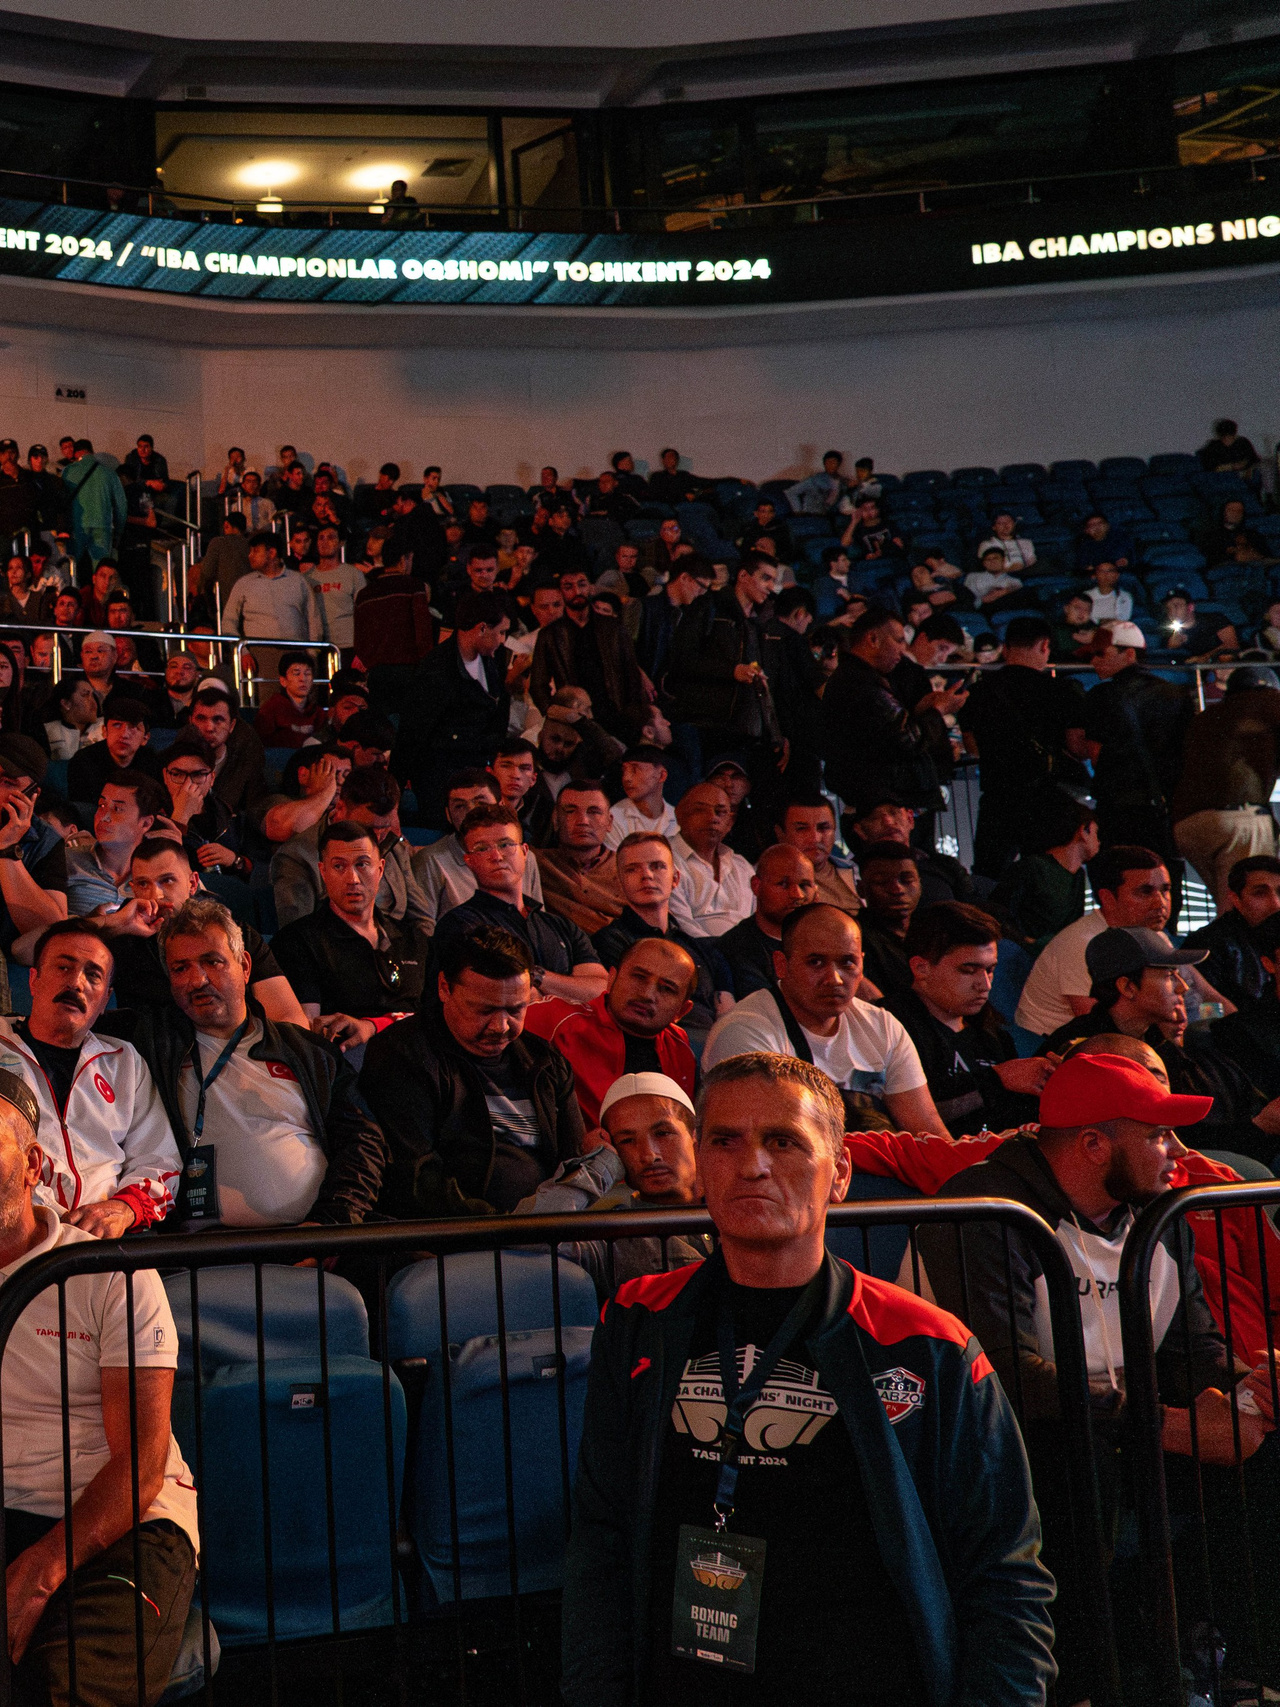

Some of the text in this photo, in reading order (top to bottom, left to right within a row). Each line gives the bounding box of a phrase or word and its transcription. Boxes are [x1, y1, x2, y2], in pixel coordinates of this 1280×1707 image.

[971, 241, 1024, 265] IBA
[1028, 223, 1215, 260] CHAMPIONS
[44, 233, 114, 261] 2024
[116, 242, 135, 267] /
[204, 252, 398, 280] CHAMPIONLAR
[553, 261, 692, 283] TOSHKENT
[695, 258, 772, 282] 2024
[882, 1381, 912, 1391] 1461
[785, 1394, 835, 1412] NIGHT
[758, 1456, 789, 1466] 2024
[690, 1604, 738, 1629] BOXING
[695, 1621, 730, 1644] TEAM
